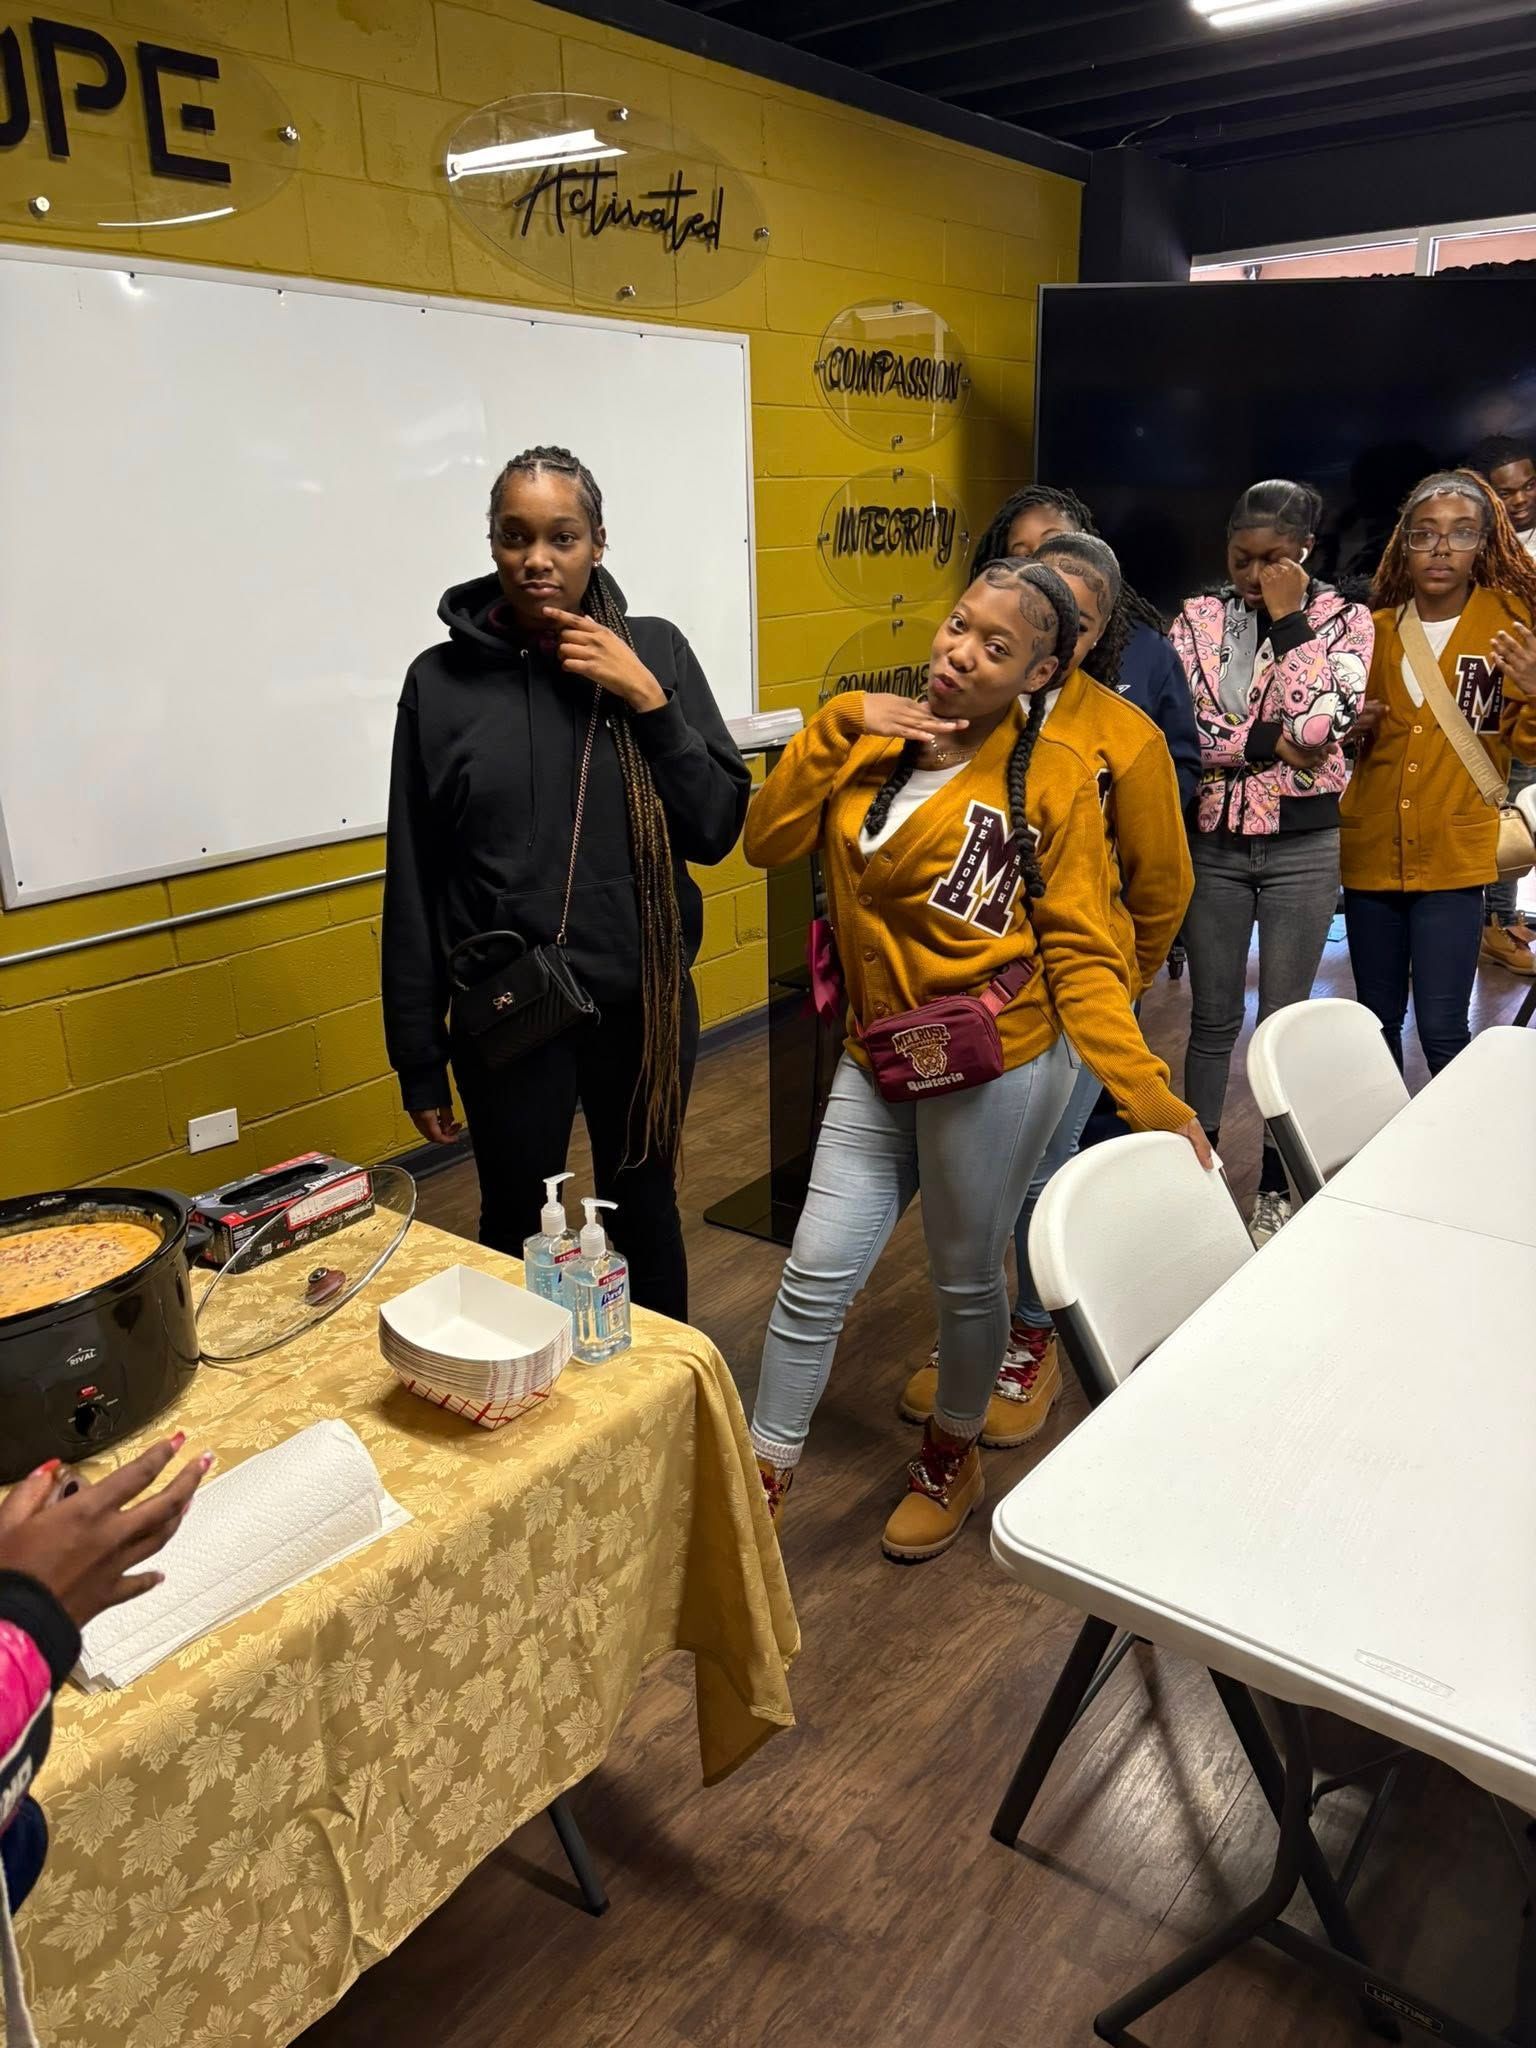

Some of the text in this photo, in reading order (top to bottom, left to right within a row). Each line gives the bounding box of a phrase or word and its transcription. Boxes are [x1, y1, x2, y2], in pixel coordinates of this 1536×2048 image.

[514, 158, 724, 250] Activated
[829, 346, 962, 402] COMPASSION
[837, 506, 956, 564] INTEGRITY
[835, 663, 930, 699] COMMITME
[949, 815, 994, 903] MELROSE
[893, 1026, 947, 1051] MELROSE
[69, 1351, 97, 1367] RIVAL
